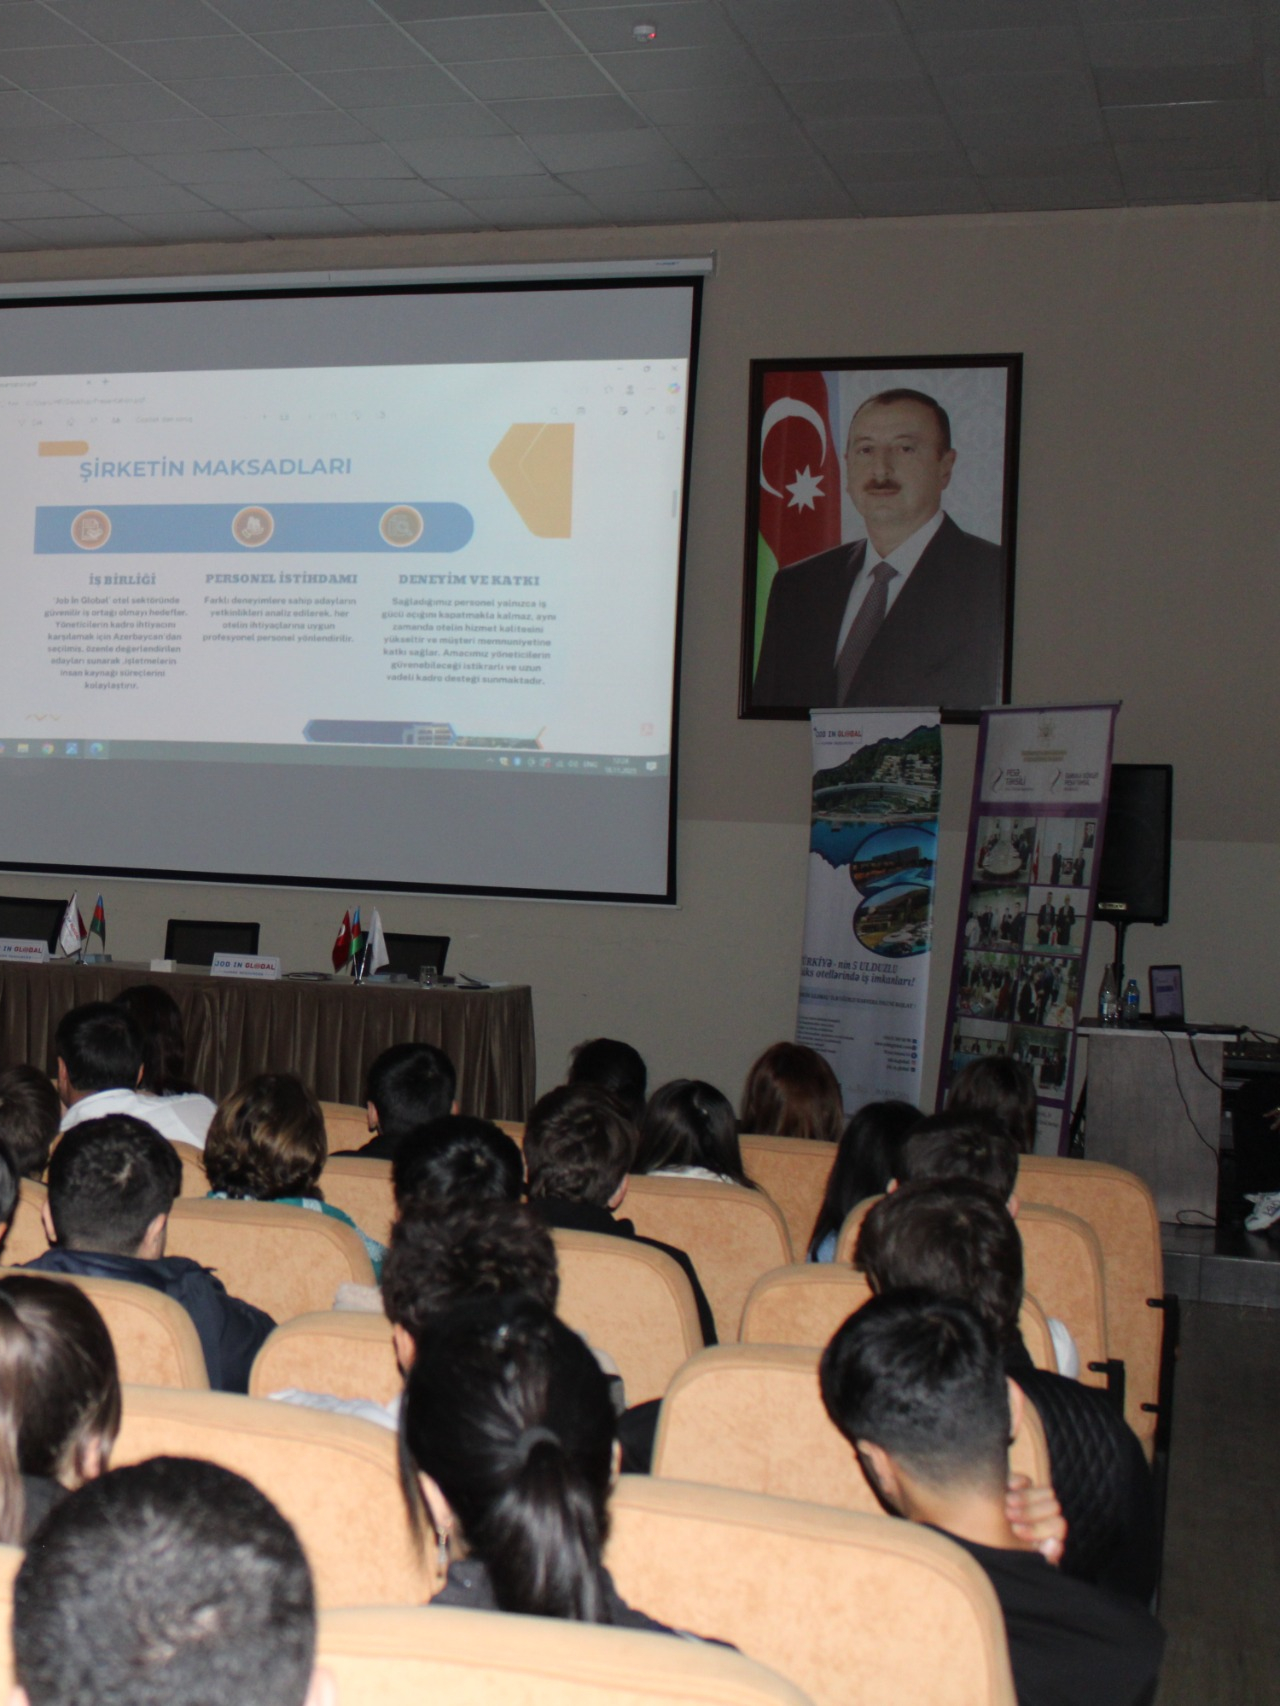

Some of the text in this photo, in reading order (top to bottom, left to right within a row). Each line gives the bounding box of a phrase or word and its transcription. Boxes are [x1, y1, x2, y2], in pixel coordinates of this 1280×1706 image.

[79, 456, 351, 482] ŞİRKETİN MAKSADLARI
[89, 572, 156, 587] İŞ BİRLİĞİ
[206, 571, 358, 584] PERSONEL İSTİHDAMI
[399, 571, 540, 586] DENEYİM VE KATKI
[132, 596, 180, 604] sektöründe
[204, 596, 356, 605] Farklı deneyimlere sahip adayların
[392, 598, 547, 608] Sağladığımız personel yalnızca iş
[44, 609, 80, 617] güvenilir
[83, 609, 89, 617] iş
[92, 609, 116, 617] ortağı
[119, 609, 147, 617] olmayı
[210, 609, 263, 617] yetkinlikleri
[382, 612, 404, 620] gücü
[406, 612, 437, 620] açığını
[439, 612, 494, 621] kapatmakla
[536, 614, 556, 622] aynı
[250, 622, 305, 630] ihtiyaçlarına
[307, 623, 335, 631] uygun
[436, 624, 462, 632] otelin
[465, 624, 497, 632] hizmet
[500, 625, 544, 633] kalitesini
[48, 634, 94, 642] karşılamak
[96, 634, 111, 642] için
[203, 634, 254, 642] profesyonel
[257, 634, 294, 642] personel
[439, 637, 475, 645] müşteri
[478, 638, 551, 647] memnuniyetine
[116, 646, 180, 654] değerlendirilen
[383, 648, 407, 656] katkı
[491, 650, 551, 659] yöneticilerin
[51, 658, 84, 666] adayları
[391, 662, 461, 670] güvenebileceği
[463, 662, 504, 670] istikrarlı
[85, 670, 118, 678] kaynağı
[120, 670, 165, 678] süreçlerini
[416, 674, 442, 682] kadro
[445, 675, 480, 683] desteği
[802, 956, 832, 968] ÜRKİYƏ
[838, 961, 851, 969] nin
[852, 961, 857, 969] 5
[859, 962, 898, 973] ULDUZLU
[816, 970, 860, 981] otellərində
[862, 973, 869, 984] iş
[871, 974, 915, 986] imkanları!
